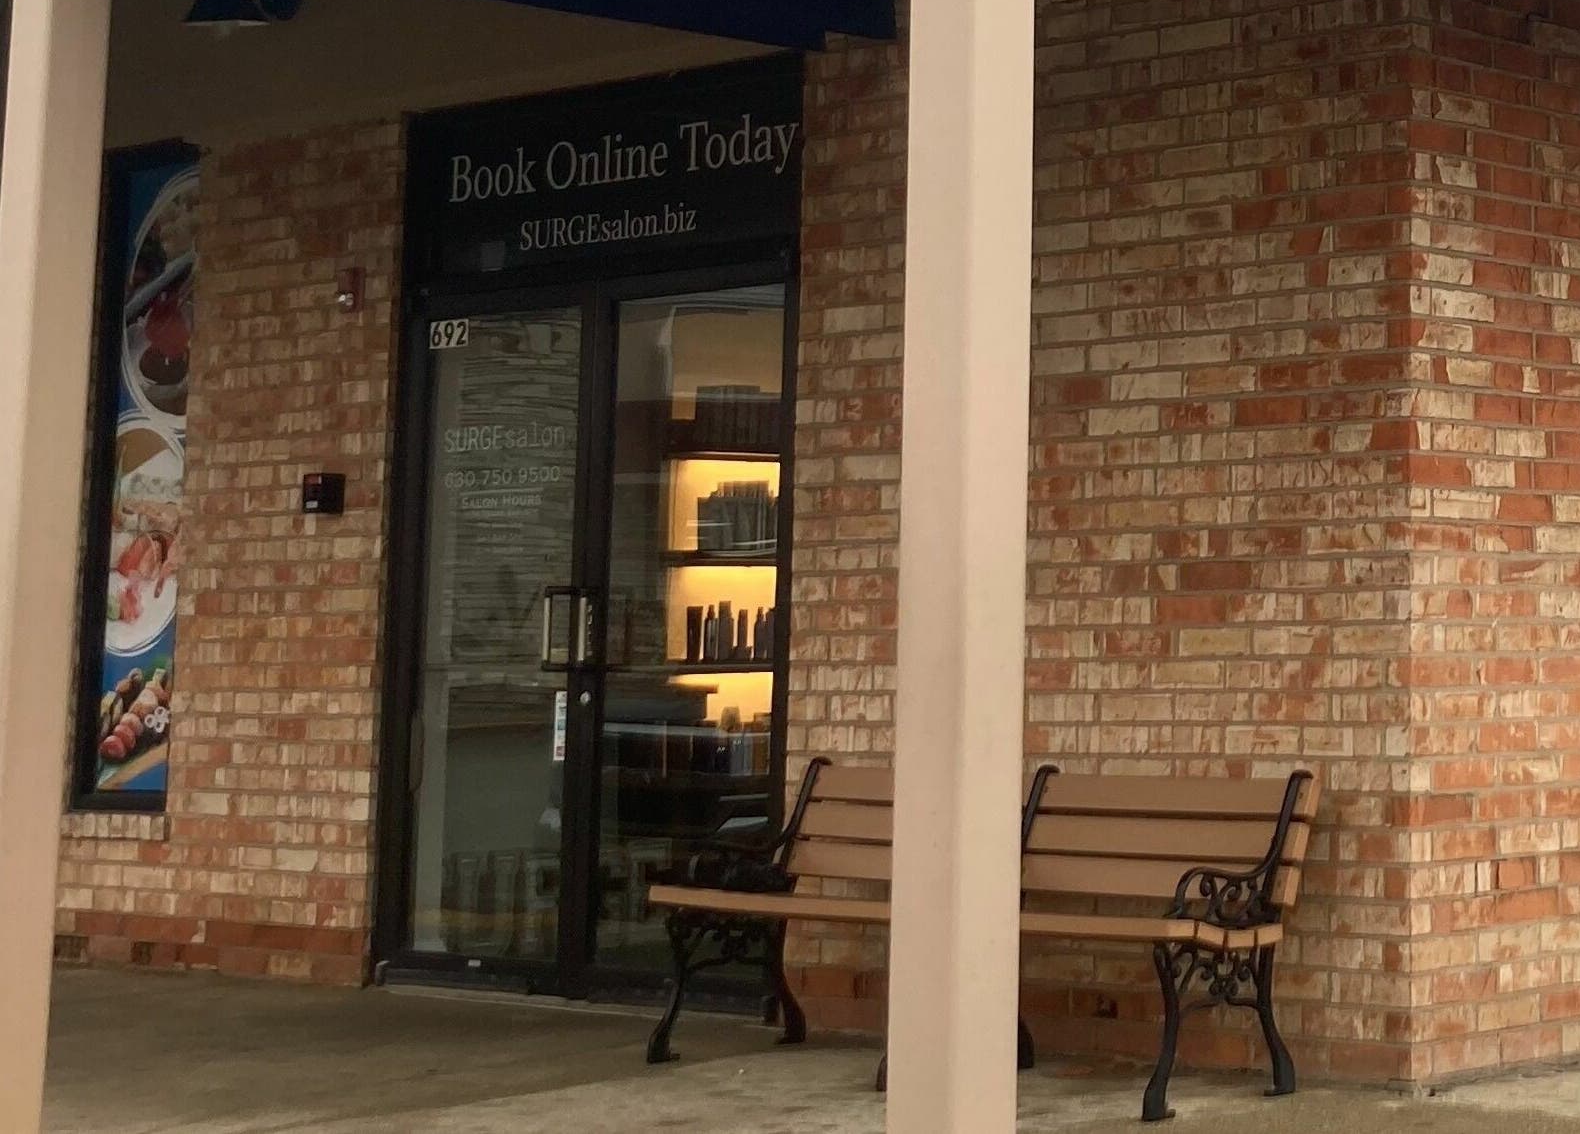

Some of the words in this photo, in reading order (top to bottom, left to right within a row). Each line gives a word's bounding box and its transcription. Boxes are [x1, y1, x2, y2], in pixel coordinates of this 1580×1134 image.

[449, 147, 536, 203] Book
[546, 133, 669, 190] Online
[679, 114, 799, 174] Today
[520, 202, 697, 251] SURGEsalon.biz
[432, 321, 466, 346] 692
[445, 422, 565, 453] SURGEsalon
